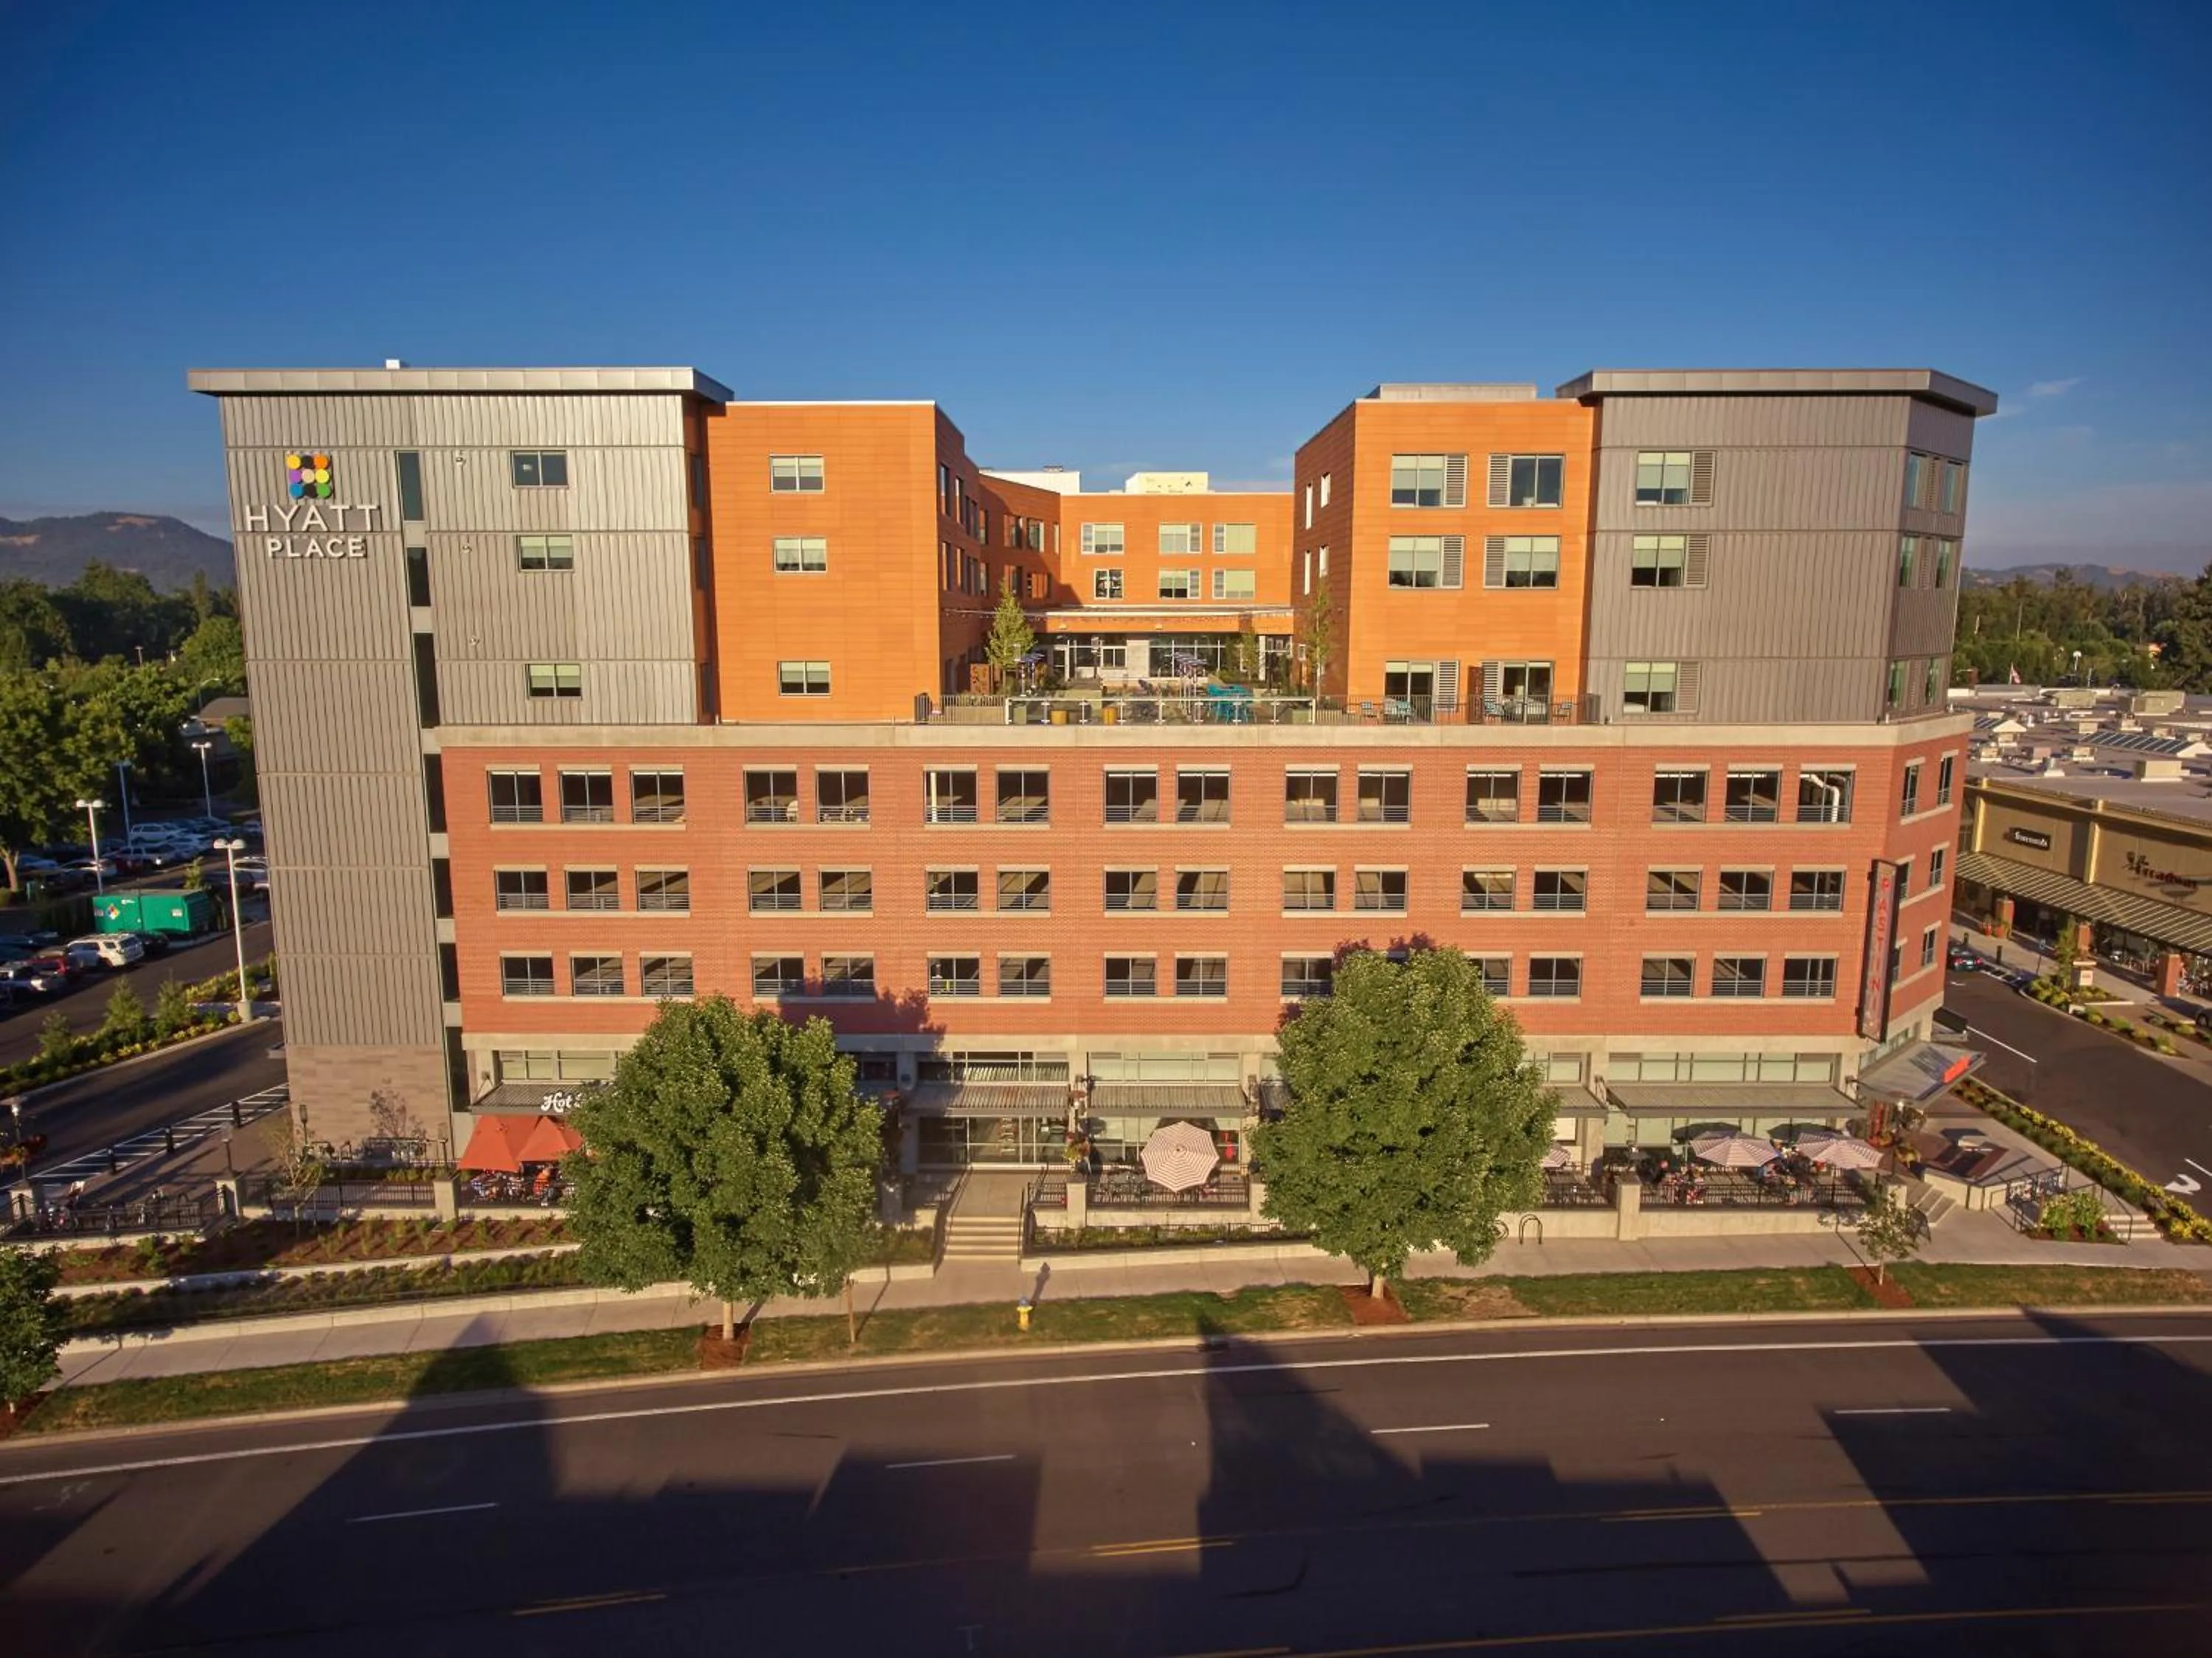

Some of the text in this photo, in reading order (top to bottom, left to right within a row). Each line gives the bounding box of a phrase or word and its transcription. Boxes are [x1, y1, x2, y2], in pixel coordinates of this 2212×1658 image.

[245, 504, 378, 532] HYATT
[266, 538, 364, 558] PLACE
[540, 1092, 573, 1113] Hot
